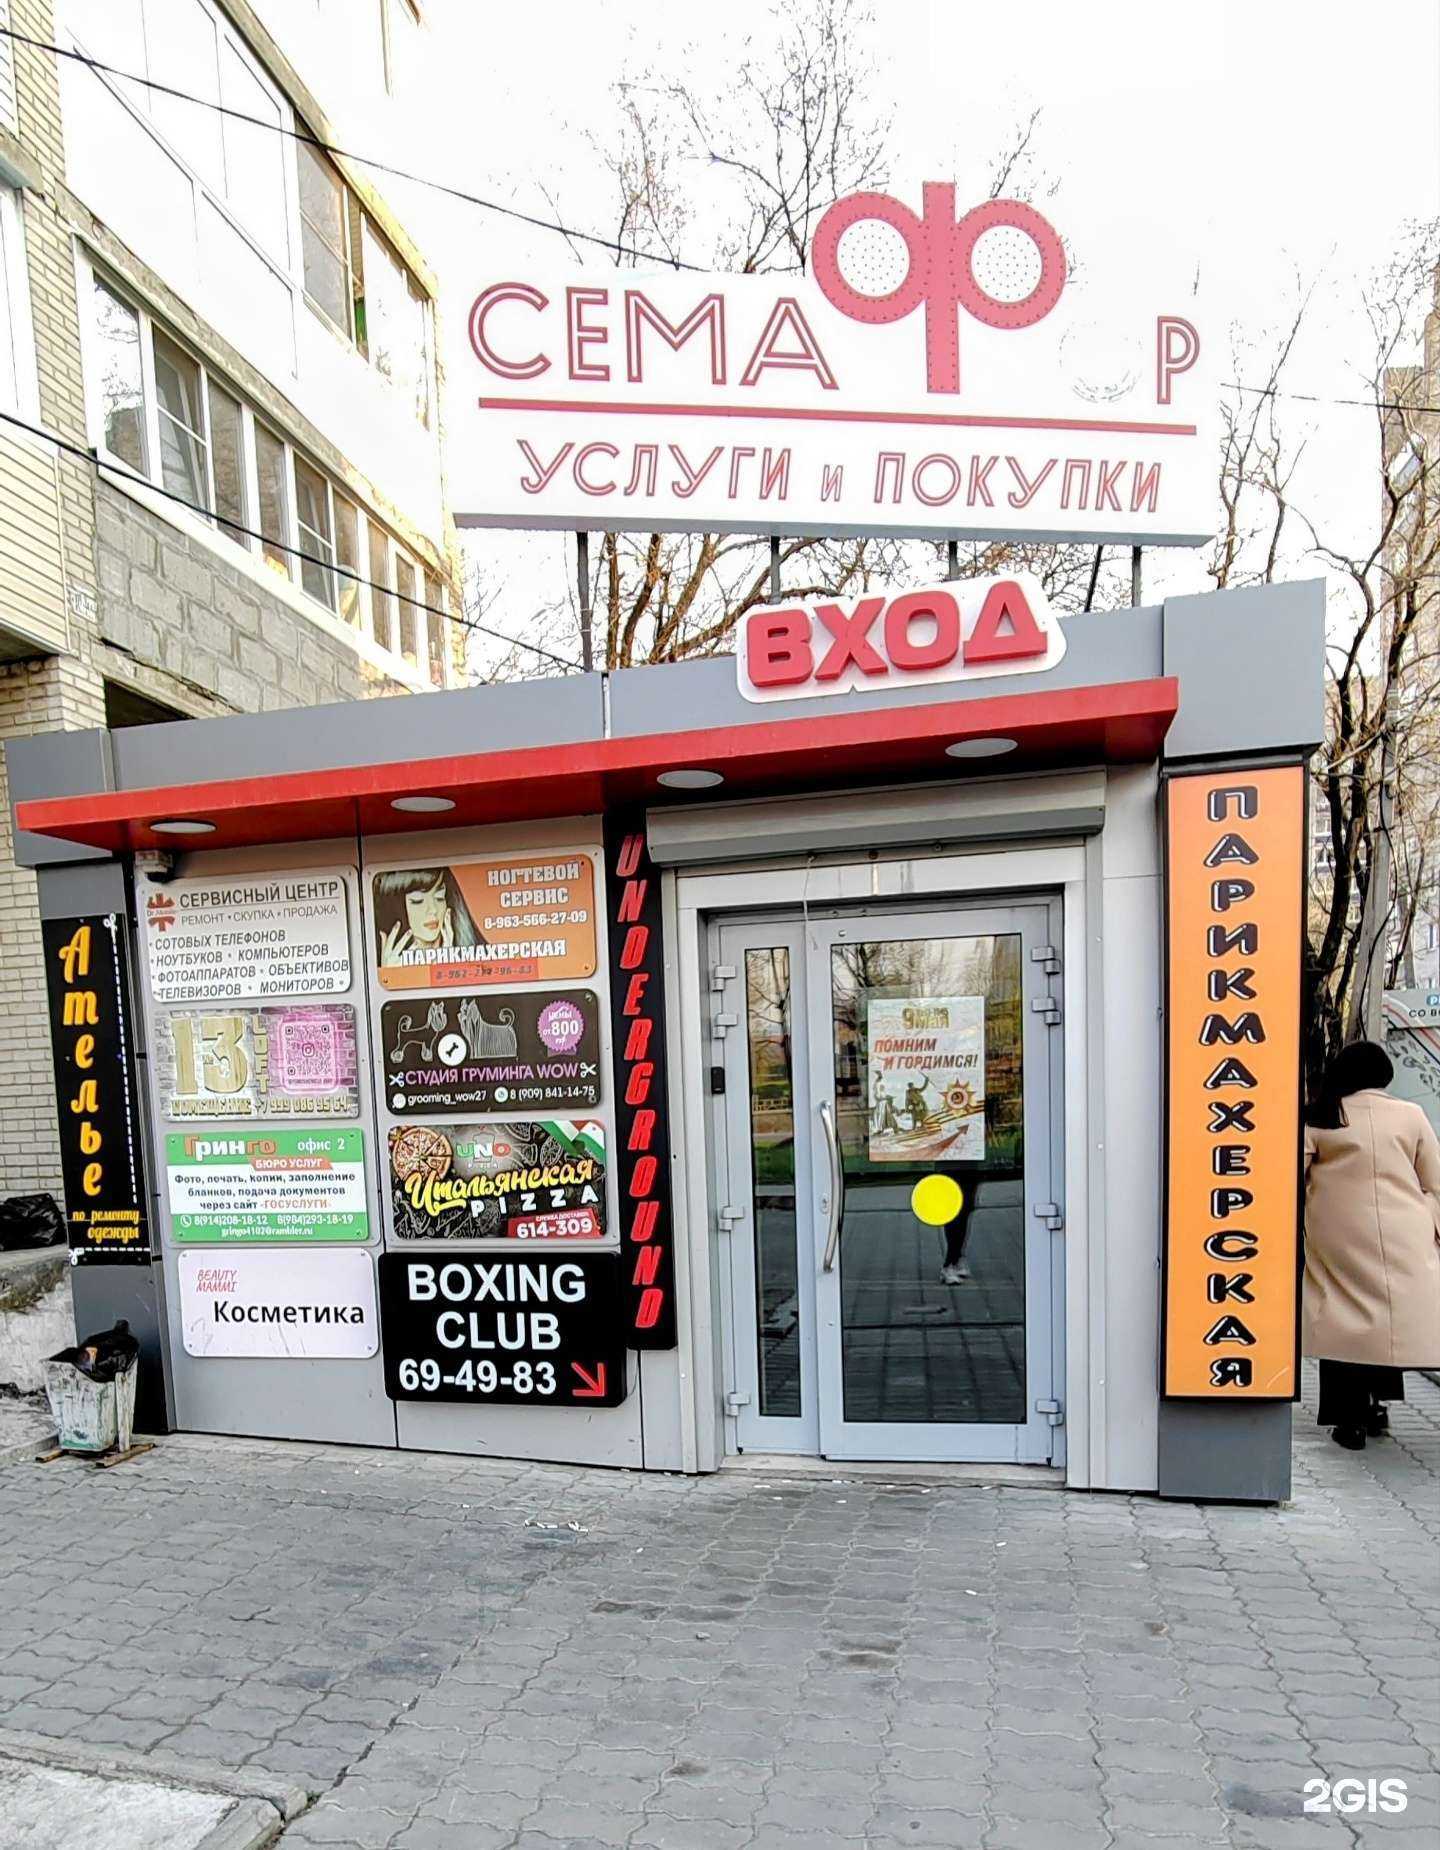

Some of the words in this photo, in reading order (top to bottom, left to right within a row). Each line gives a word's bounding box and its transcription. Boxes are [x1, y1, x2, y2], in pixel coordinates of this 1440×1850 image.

[516, 439, 791, 500] УСЛУГИ
[820, 464, 844, 502] и
[873, 452, 1162, 513] ПОКУПКИ
[746, 580, 1049, 688] ВХОД
[488, 861, 580, 887] НОГТЕВОЙ
[179, 882, 281, 909] СЕРВИСНЫЙ
[285, 881, 339, 900] ЦЕНТР
[500, 887, 569, 909] СЕРВИС
[181, 913, 224, 926] РЕМОНТ
[233, 909, 275, 922] СКУПКА
[283, 905, 338, 918] ПРОДАЖА
[155, 934, 212, 950] СОТОВЫХ
[215, 929, 286, 947] ТЕЛЕФОНОВ
[156, 951, 223, 967] НОУТБУКОВ
[238, 943, 329, 962] КОМПЬЮТЕРОВ
[401, 938, 567, 967] ПАРИКМАХЕРСКАЯ
[157, 966, 256, 984] ФОТОАППАРАТОВ
[268, 959, 349, 976] ОБЪЕКТИВОВ
[160, 982, 242, 1000] ТЕЛЕВИЗОРОВ
[260, 977, 334, 994] МОНИТОРОВ
[551, 1020, 579, 1036] 800
[170, 1015, 248, 1094] 13
[874, 1038, 937, 1053] ПОМНИМ
[59, 926, 102, 1197] Ателье
[883, 1057, 895, 1071] И
[897, 1054, 979, 1071] ГОРДИМСЯ!
[405, 1069, 458, 1086] СТУДИЯ
[462, 1065, 534, 1084] ГРУМИНГА
[537, 1062, 579, 1079] WOW
[615, 834, 663, 1329] UNDERGROUND
[407, 1090, 487, 1106] grooming_wow27
[509, 1089, 516, 1100] 8
[518, 1087, 543, 1102] (909)
[545, 1085, 595, 1099] 841-14-75
[1198, 785, 1266, 1388] ПАРИКМАХЕРСКАЯ
[184, 1136, 276, 1161] Гринго
[297, 1138, 331, 1154] офис
[337, 1138, 345, 1150] 2
[255, 1159, 288, 1169] БЮРО
[289, 1157, 323, 1168] УСЛУГ
[174, 1174, 205, 1185] Фото,
[207, 1174, 247, 1184] печать,
[250, 1173, 286, 1183] копии,
[288, 1173, 356, 1182] заполнение
[404, 1158, 594, 1217] Итальянская
[188, 1186, 235, 1198] бланков,
[238, 1187, 277, 1198] подача
[279, 1186, 346, 1198] документов
[471, 1184, 599, 1218] PIZZA
[72, 1211, 86, 1222] по
[91, 1210, 139, 1225] ремонту
[200, 1200, 231, 1212] через
[233, 1199, 258, 1210] сайт
[87, 1227, 139, 1244] одежды
[517, 1219, 593, 1239] 614-309
[197, 1269, 238, 1281] BEAUTY
[407, 1263, 586, 1302] BOXING
[214, 1300, 365, 1324] Косметика
[436, 1311, 561, 1350] CLUB
[399, 1358, 557, 1394] 69-49-83
